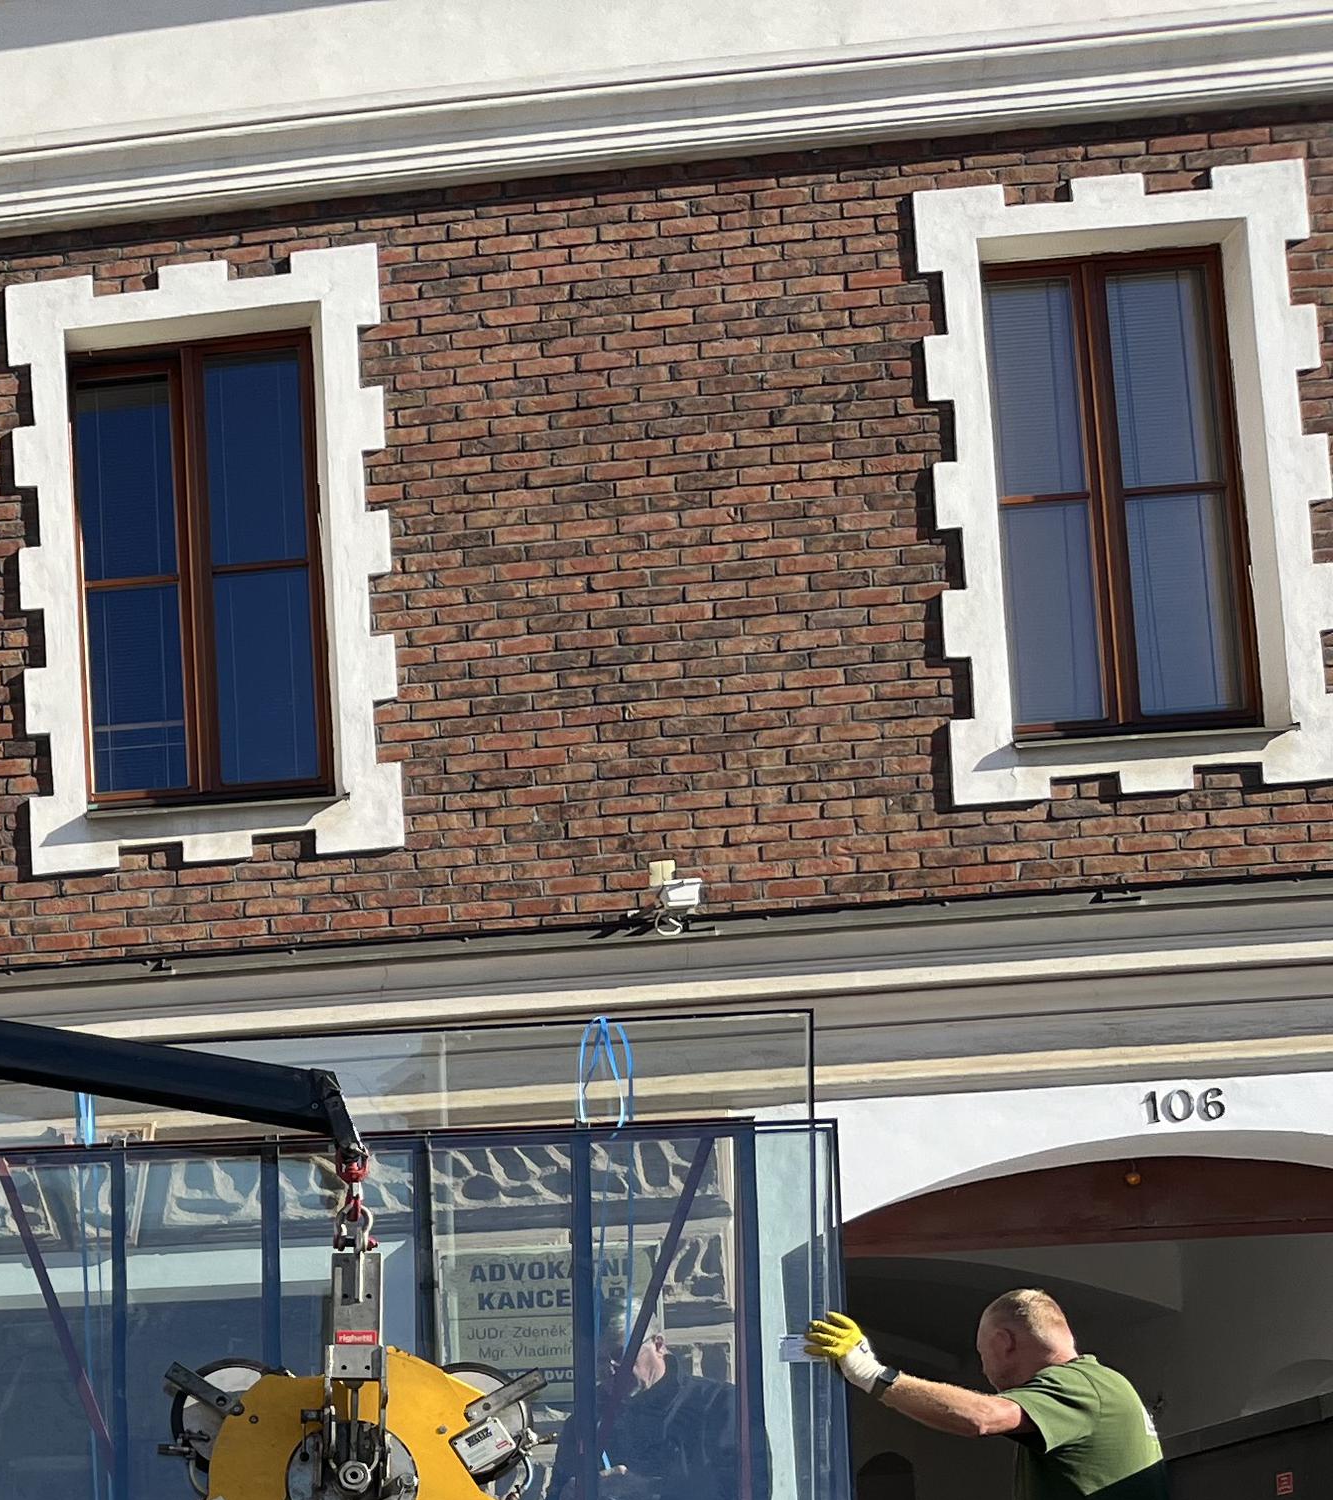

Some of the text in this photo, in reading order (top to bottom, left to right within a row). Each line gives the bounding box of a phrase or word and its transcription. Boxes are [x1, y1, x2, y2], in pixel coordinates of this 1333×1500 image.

[1139, 1087, 1226, 1125] 106
[478, 1280, 626, 1311] KANCEŘ
[513, 1325, 566, 1339] Zdeněk
